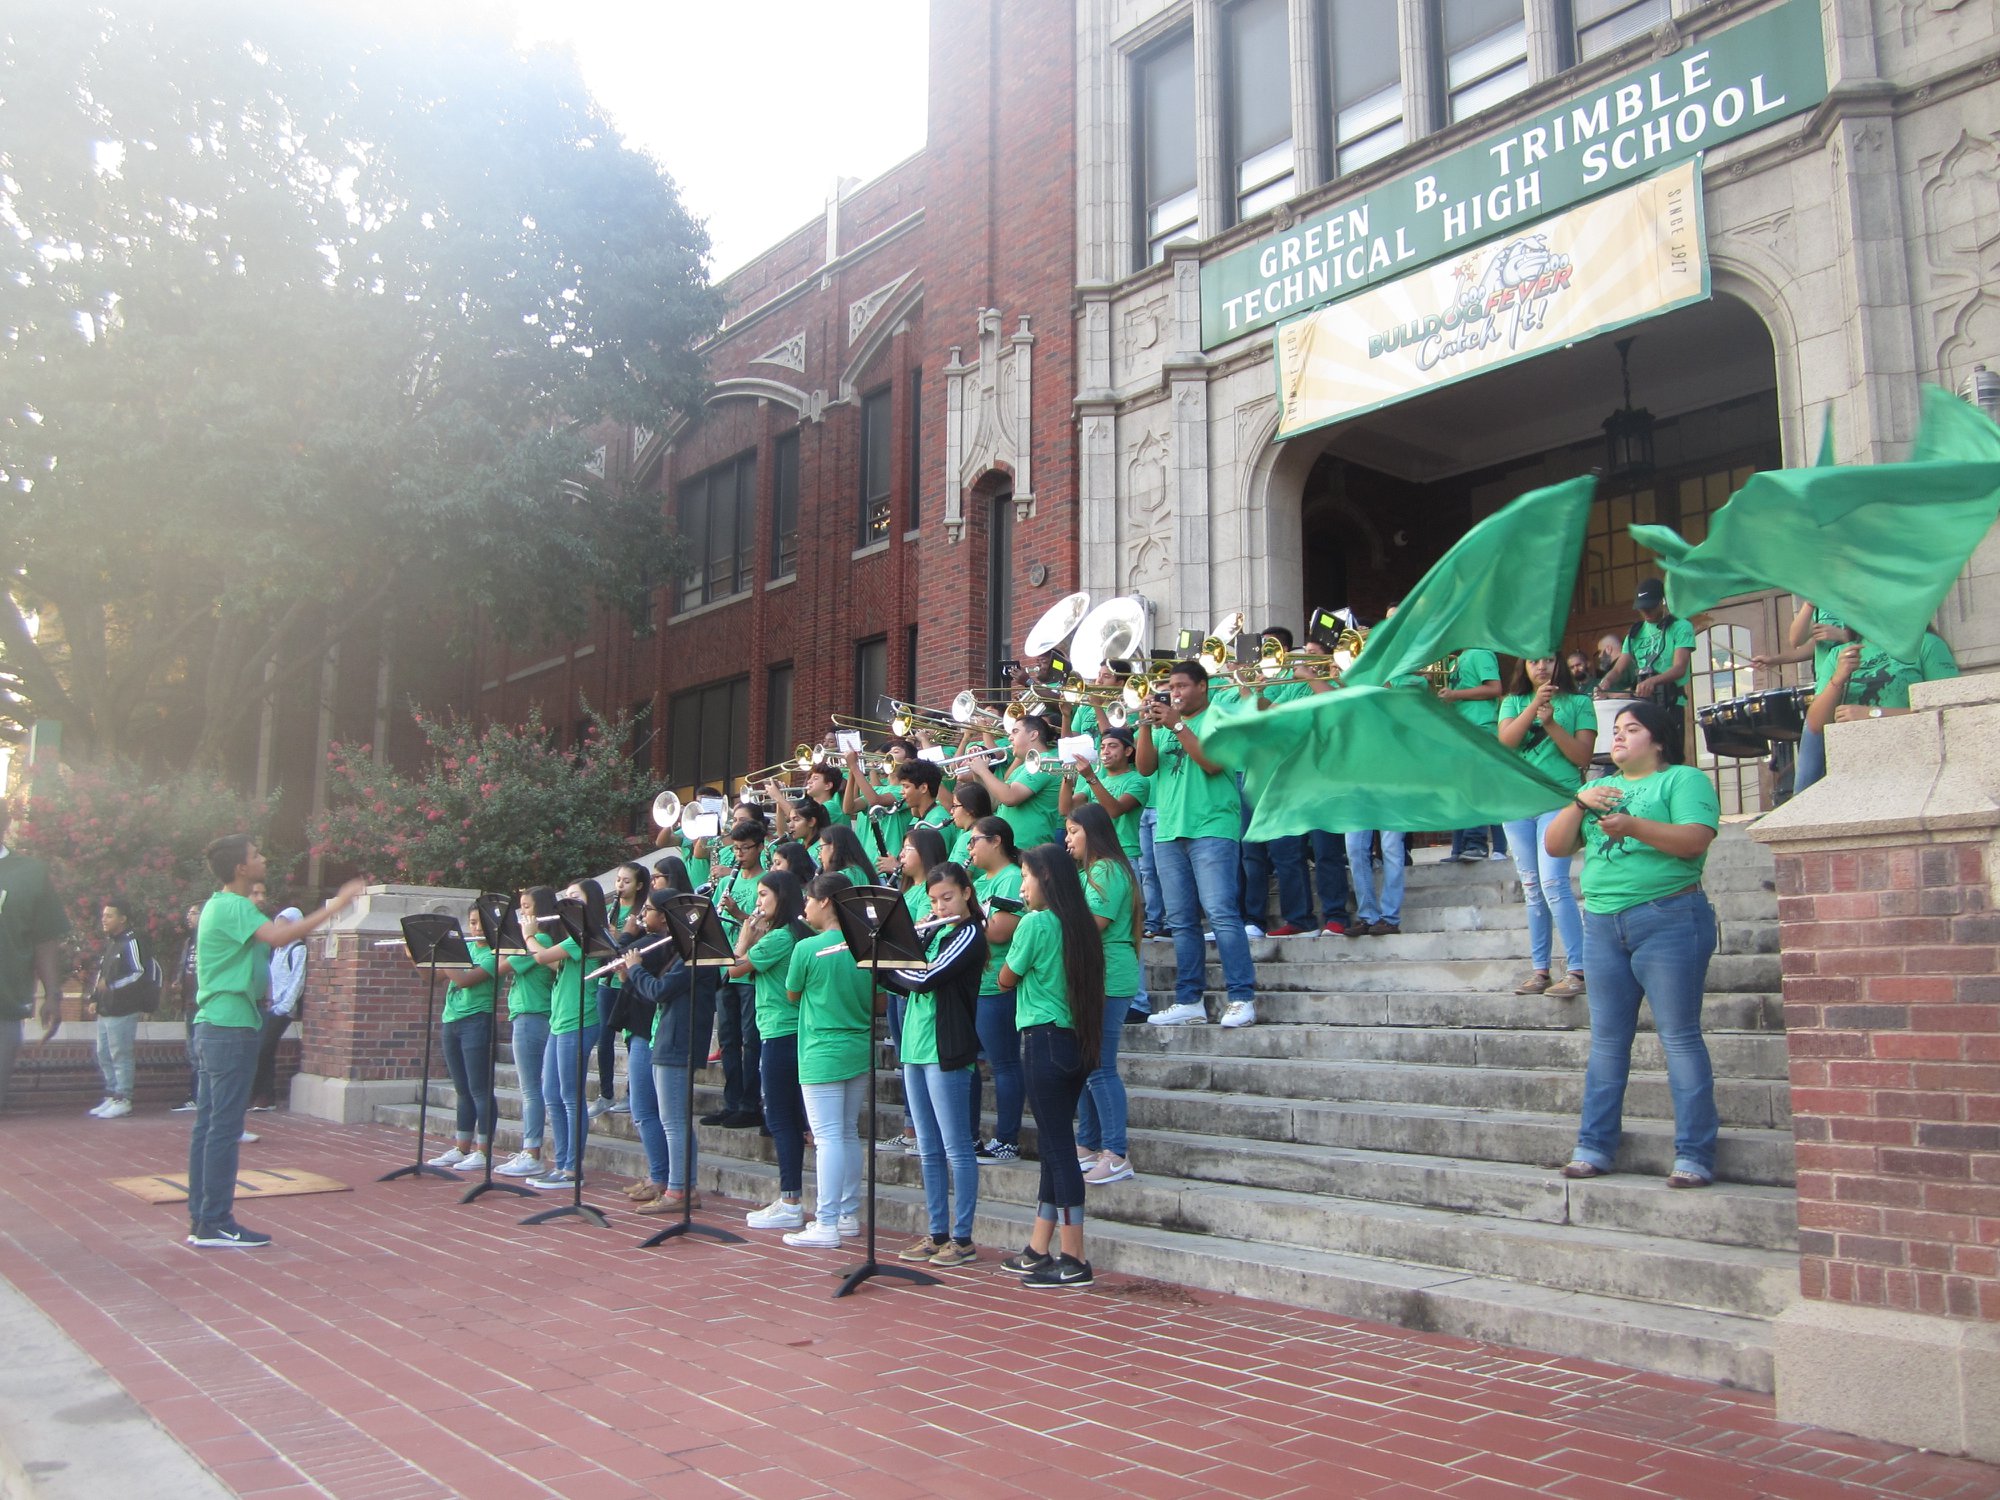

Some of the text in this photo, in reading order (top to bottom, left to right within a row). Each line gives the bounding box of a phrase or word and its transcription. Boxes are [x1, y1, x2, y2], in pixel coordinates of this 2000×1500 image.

[1222, 74, 1785, 331] TECHNICAL HIGH SCHOOL
[1260, 50, 1712, 278] GREEN B. TRIMBLE
[1667, 188, 1687, 273] SINCE 1917
[1368, 264, 1573, 359] BULLDOG FEVER
[1415, 299, 1548, 371] Catch It!
[1287, 368, 1299, 421] TRIME
